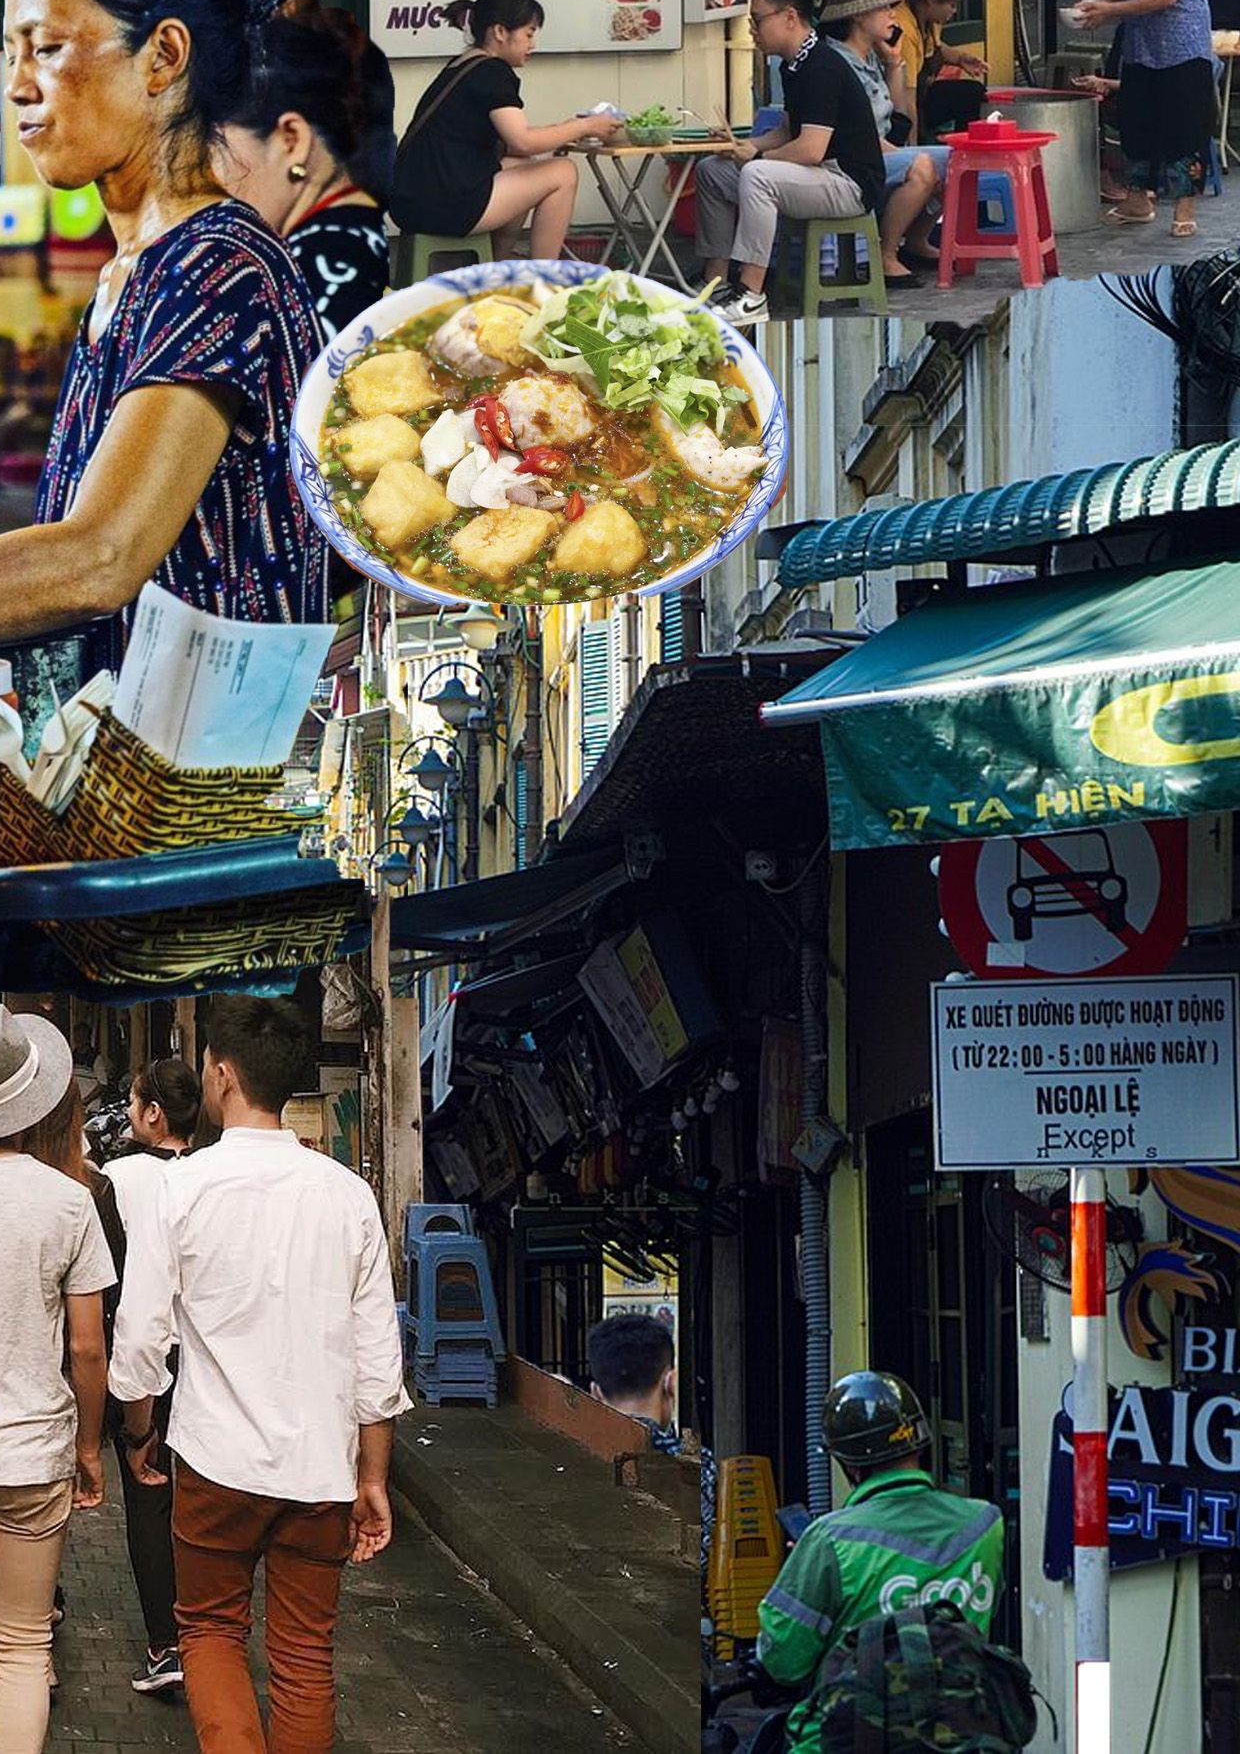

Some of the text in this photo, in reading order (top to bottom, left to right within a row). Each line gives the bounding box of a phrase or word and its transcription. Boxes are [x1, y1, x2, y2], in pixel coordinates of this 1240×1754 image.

[888, 804, 931, 832] 27
[1035, 779, 1145, 819] HIỆN
[946, 994, 1224, 1029] XE QUÉT ĐƯỜNG ĐƯỢC HOẠT ĐỘNG
[988, 1043, 1043, 1068] 22:00
[1111, 1037, 1156, 1066] HÀNG
[1036, 1078, 1140, 1118] NGOẠI LỆ
[1044, 1123, 1136, 1155] Except
[878, 1561, 995, 1615] Grab
